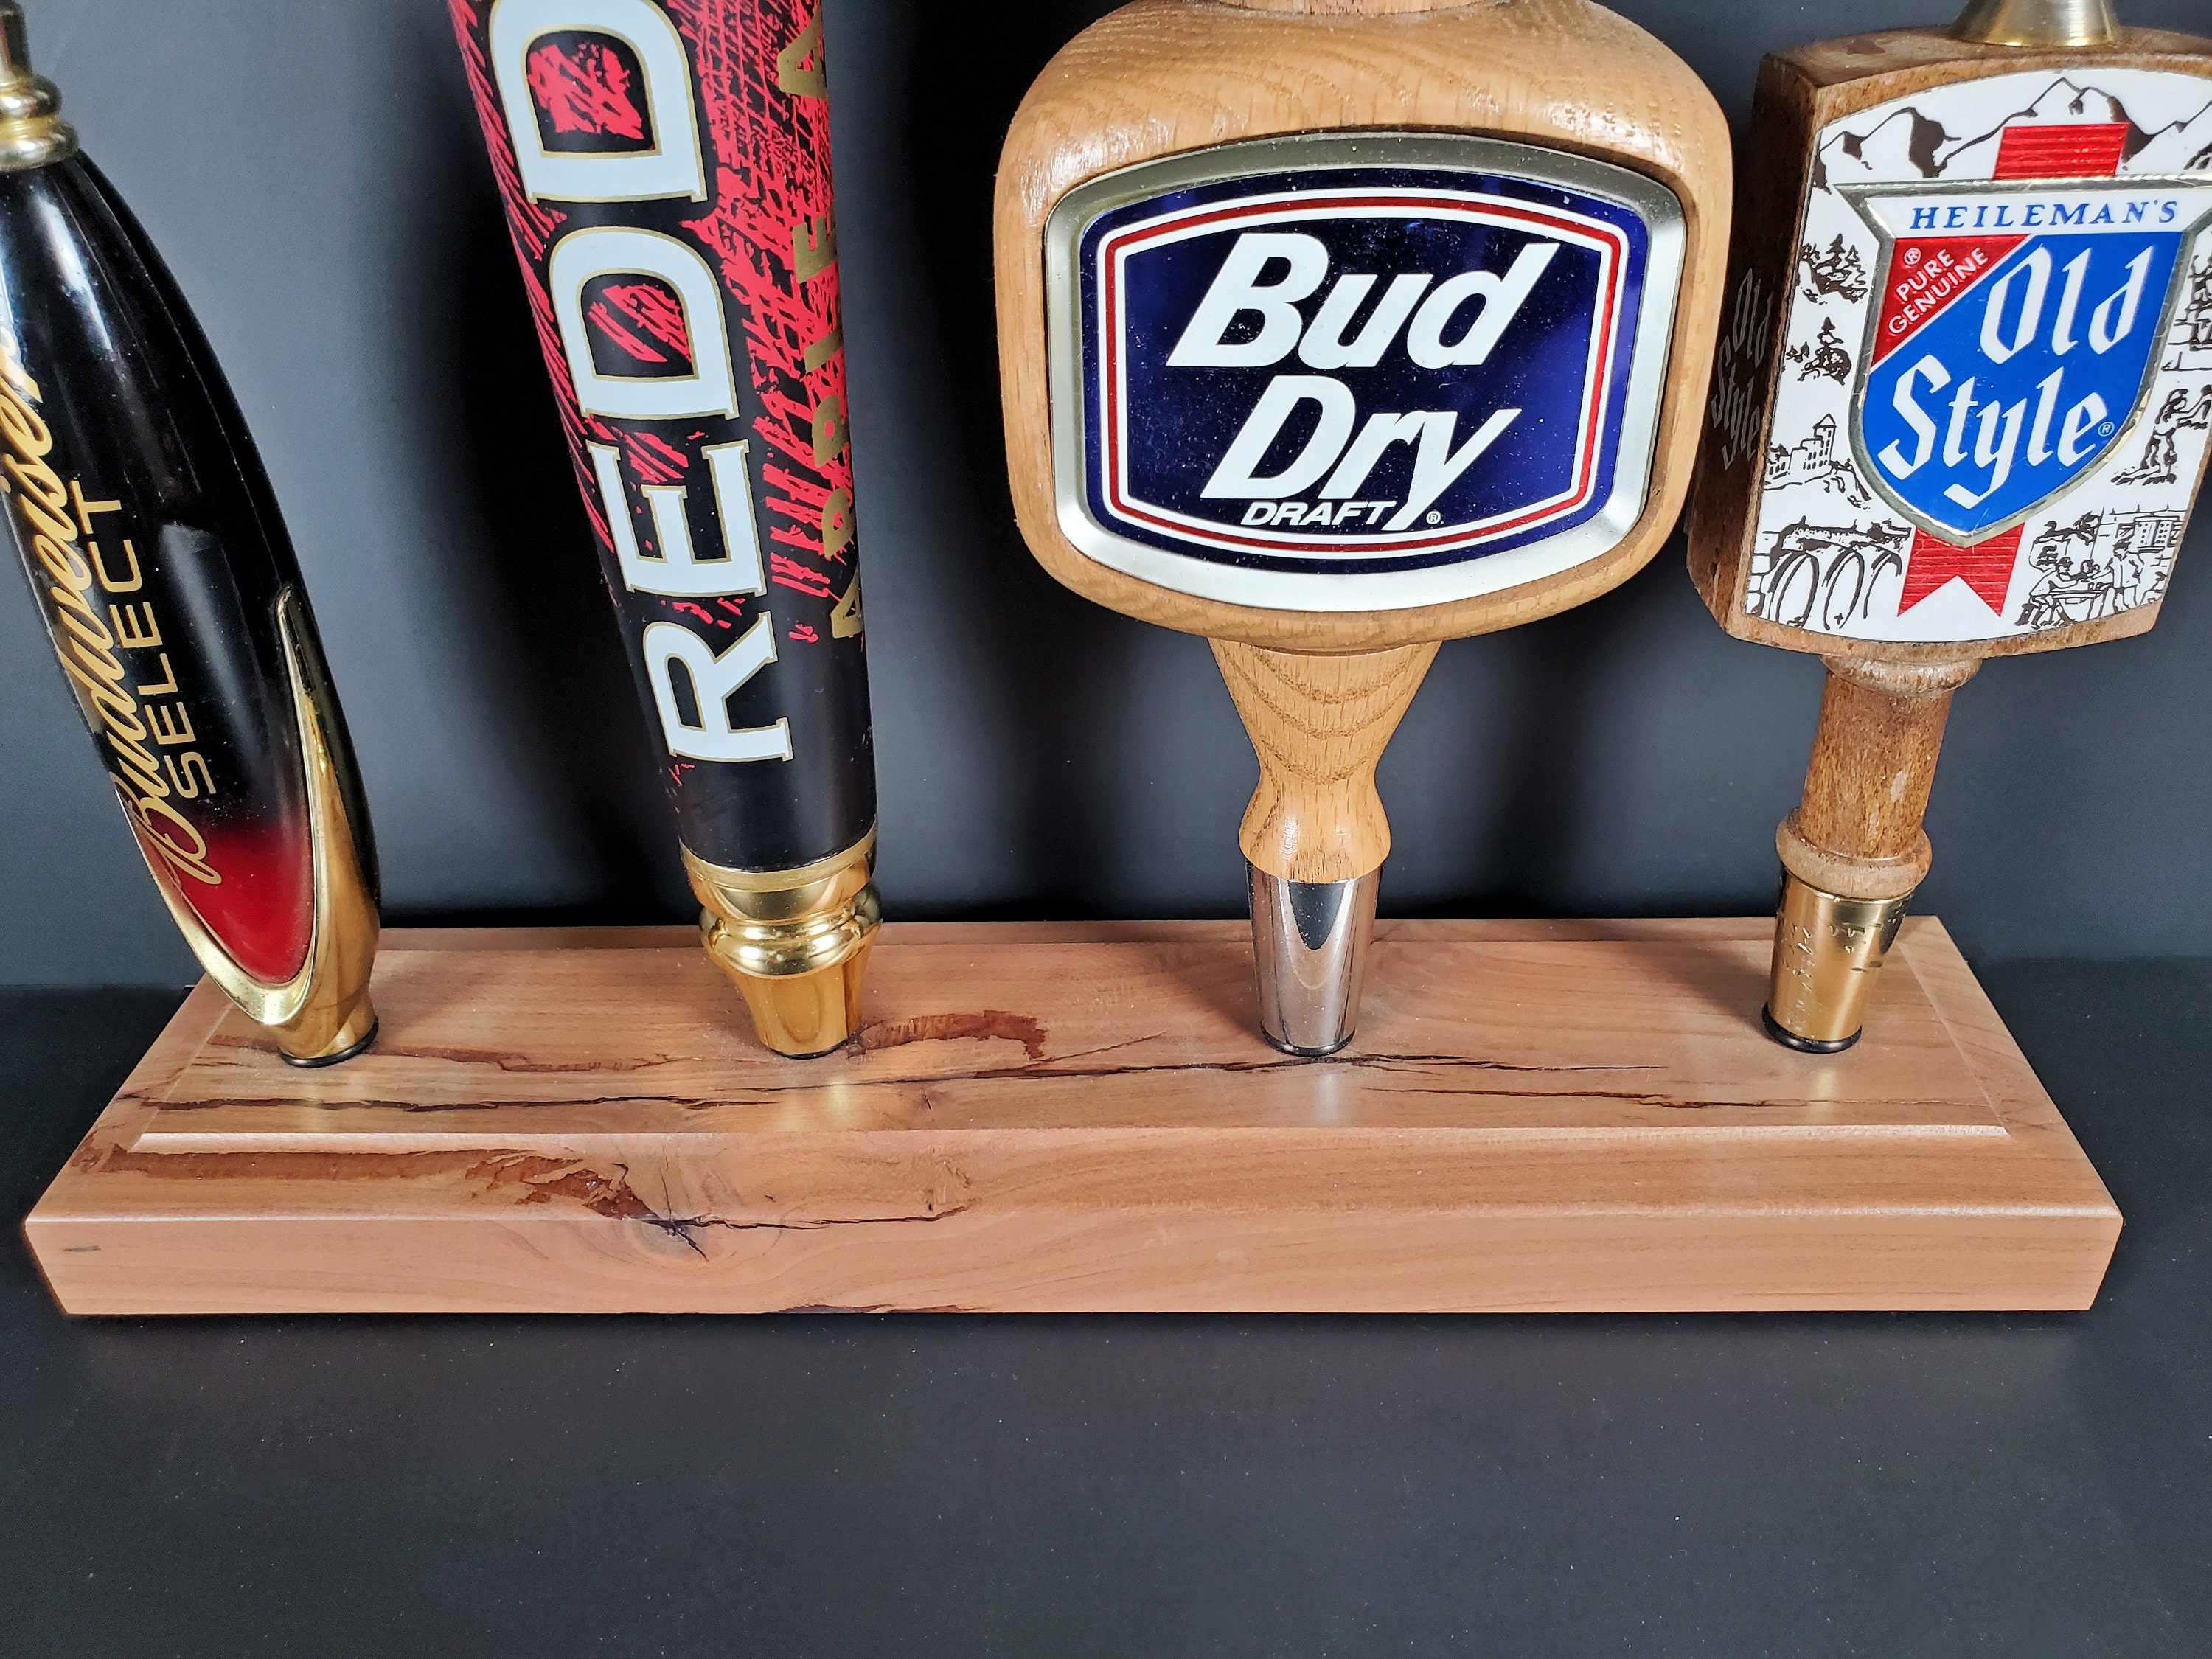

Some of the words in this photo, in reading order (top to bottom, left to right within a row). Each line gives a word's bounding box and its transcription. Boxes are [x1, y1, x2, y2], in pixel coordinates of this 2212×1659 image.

[1910, 199, 2178, 230] HEILEMAN'S
[1166, 233, 1560, 369] Bud
[1888, 247, 1989, 334] GENUINE
[1896, 248, 1955, 302] PURE
[1979, 244, 2154, 364] Old
[1200, 375, 1522, 531] Dry
[1878, 362, 2109, 509] Style
[1240, 501, 1397, 526] DRAFT
[69, 479, 217, 799] SELECT
